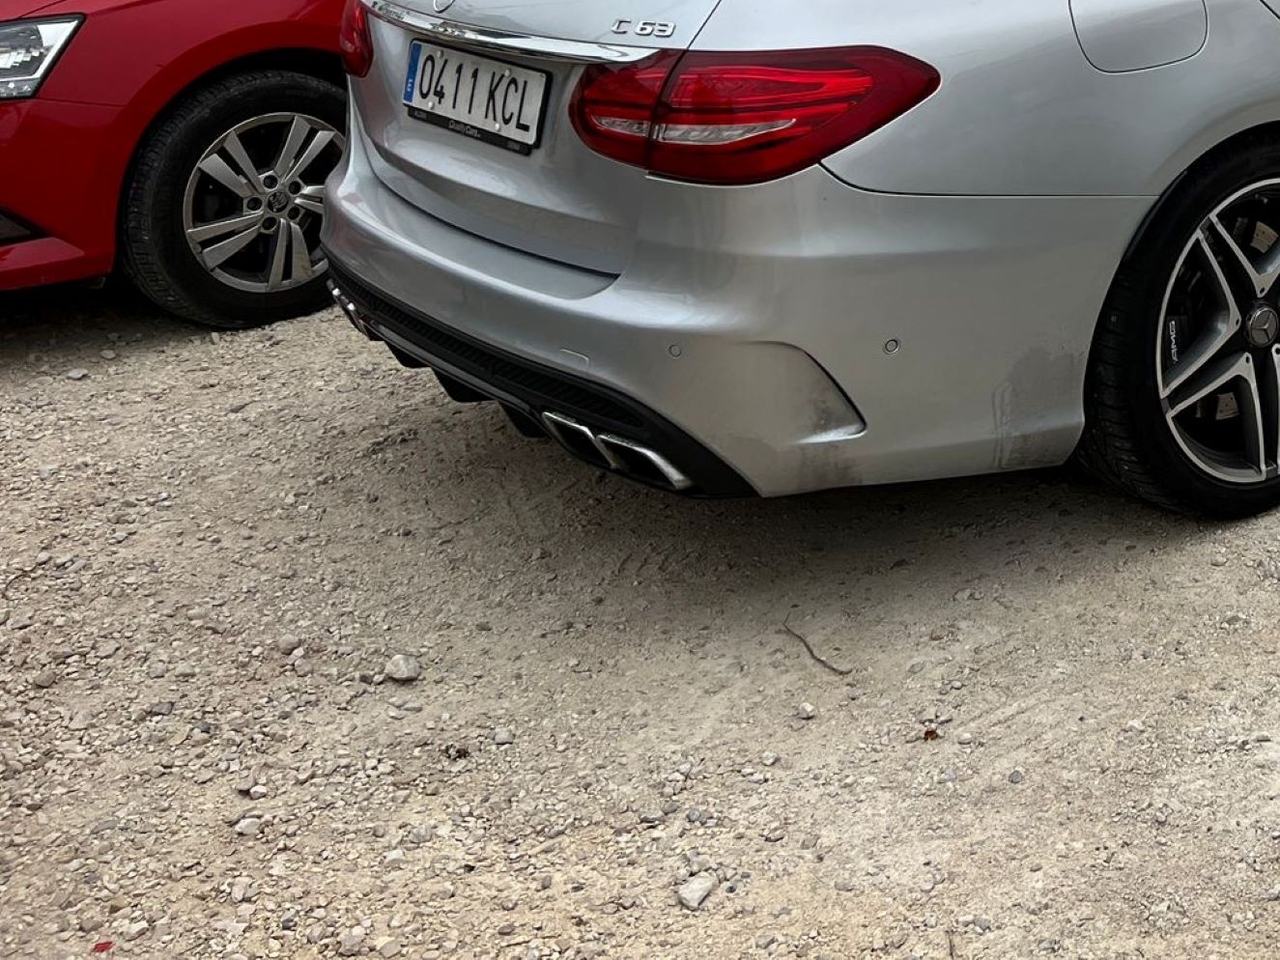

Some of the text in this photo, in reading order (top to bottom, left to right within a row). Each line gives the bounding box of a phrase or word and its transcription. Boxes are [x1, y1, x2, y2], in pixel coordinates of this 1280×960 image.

[611, 19, 677, 38] C 63
[419, 54, 531, 133] 0411 KCL
